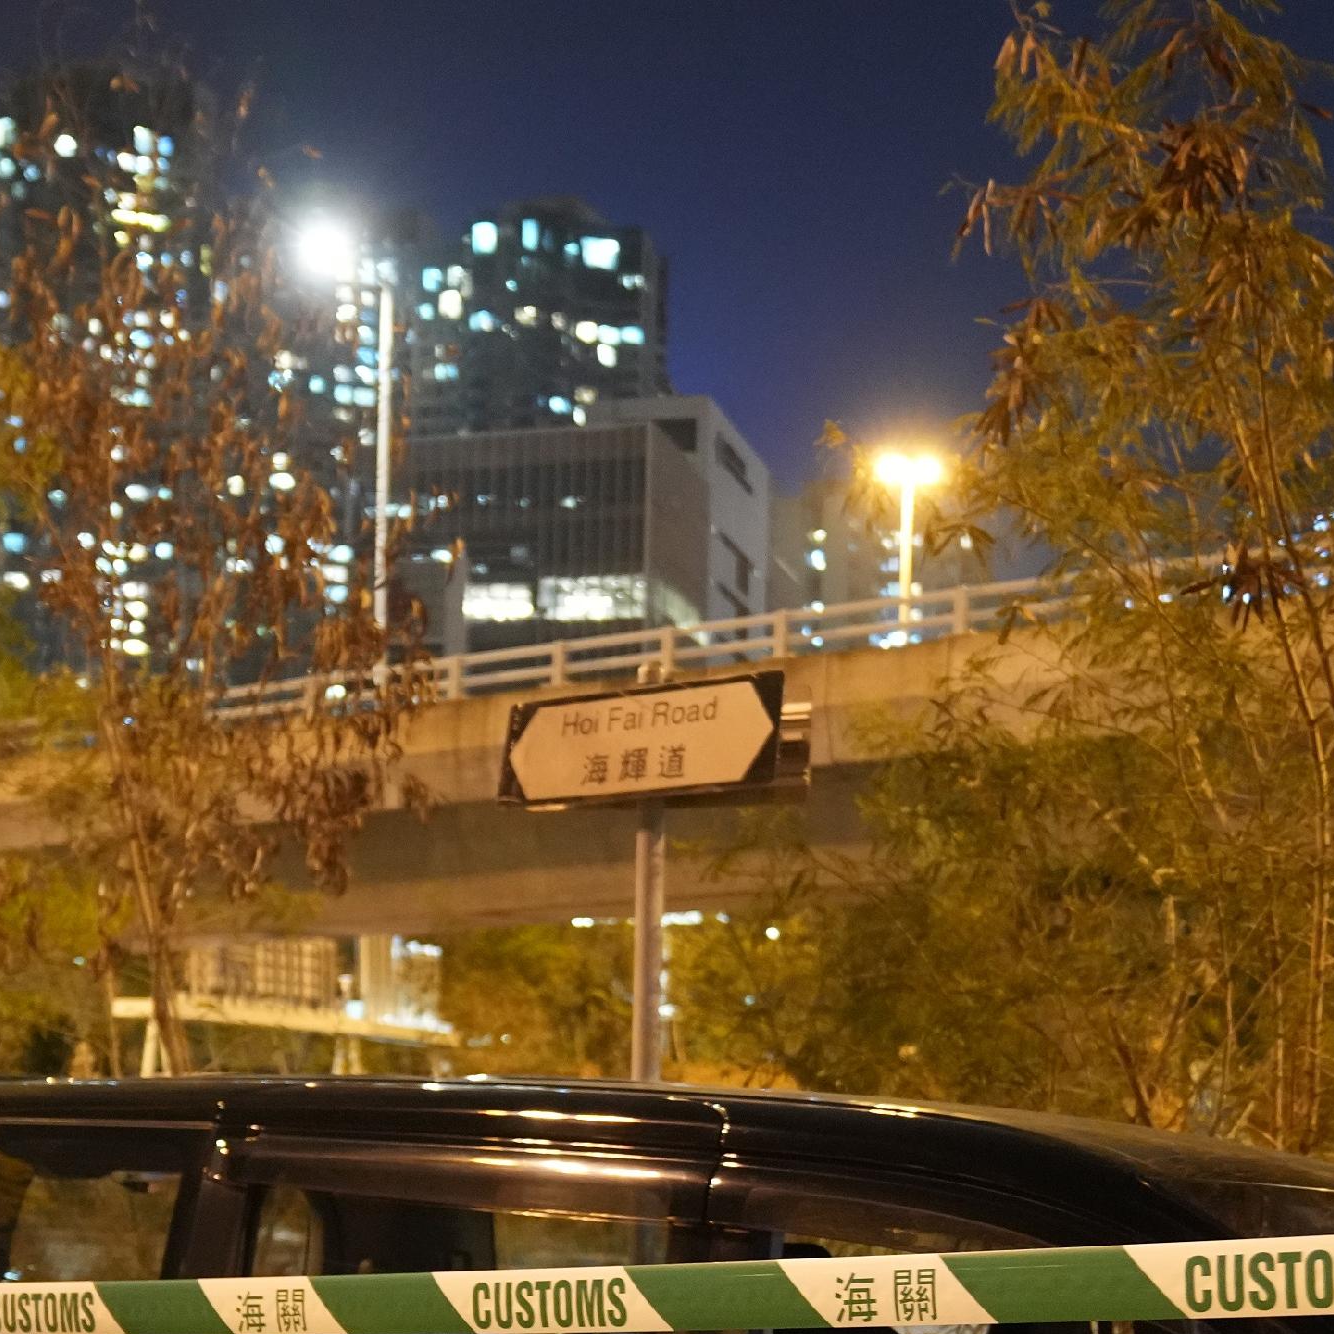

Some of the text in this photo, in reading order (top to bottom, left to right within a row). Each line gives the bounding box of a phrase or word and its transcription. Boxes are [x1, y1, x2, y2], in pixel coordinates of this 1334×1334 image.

[561, 695, 720, 738] Hoi Fai Road
[580, 743, 687, 787] 海輝道
[234, 1287, 308, 1334] 海關
[471, 1277, 628, 1330] CUSTOMS
[834, 1268, 939, 1323] 海關
